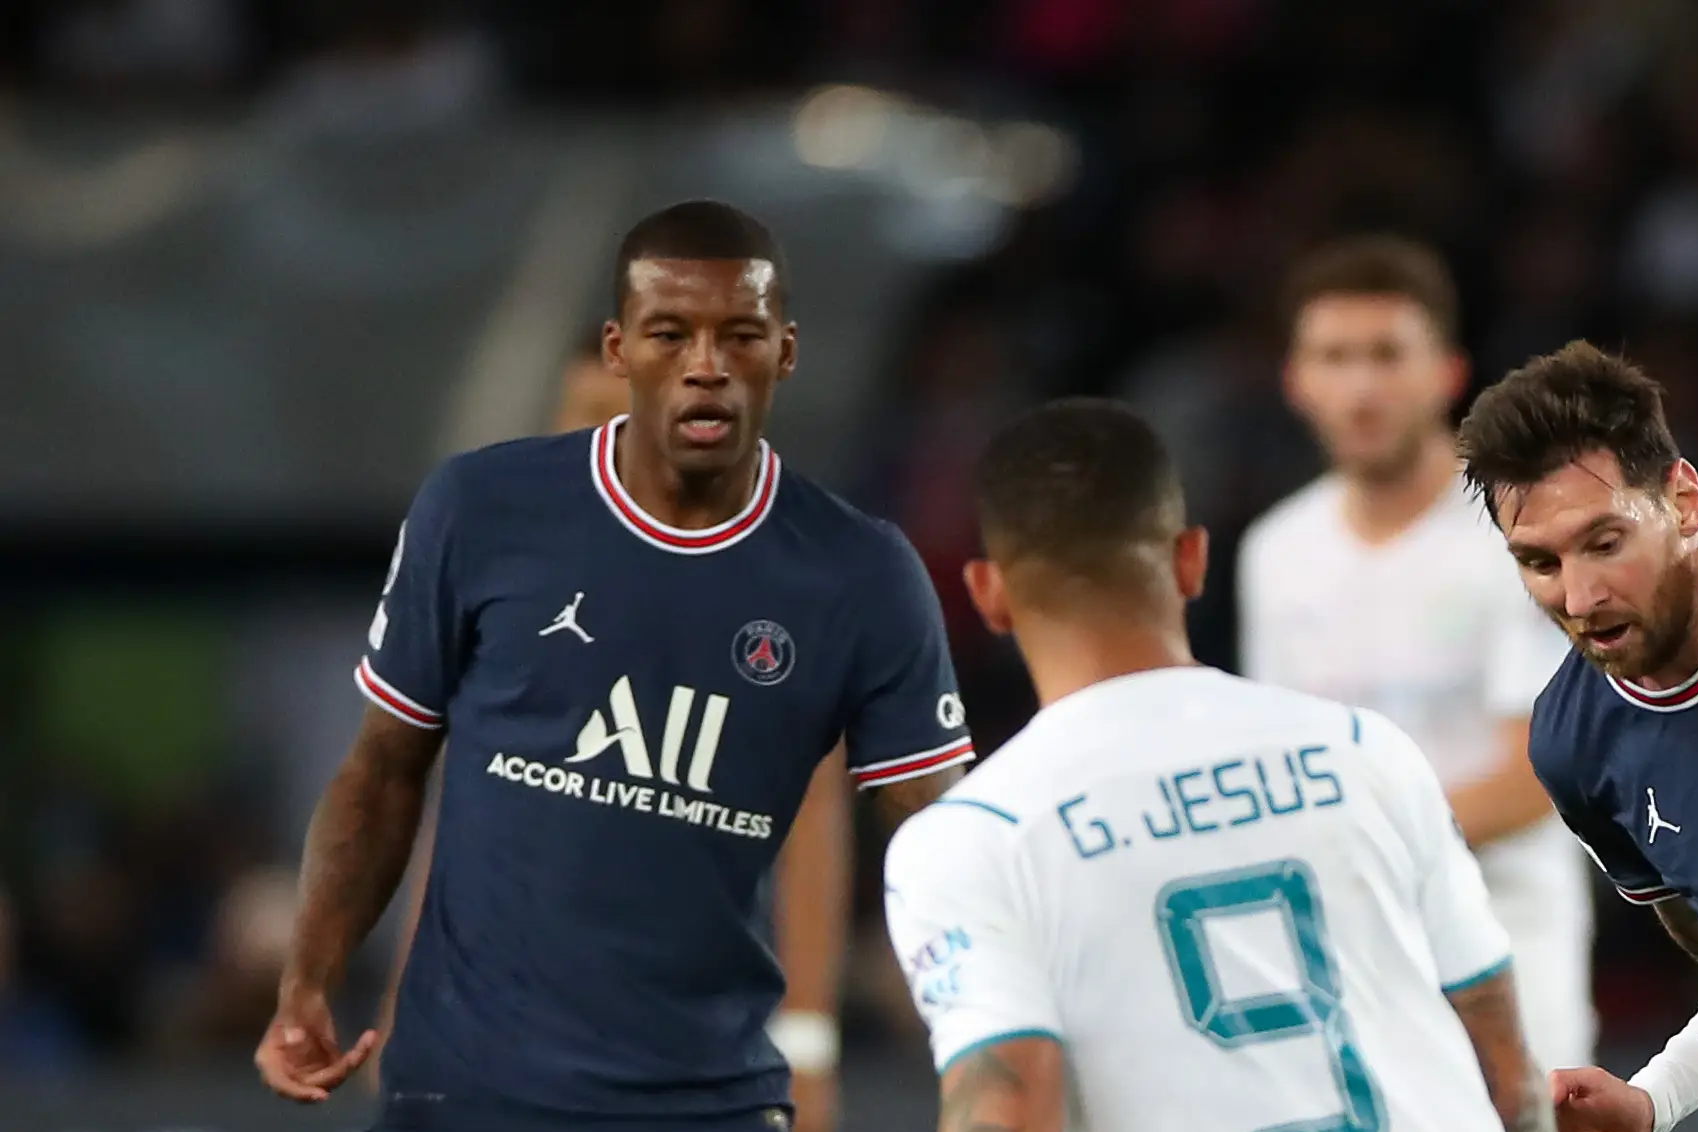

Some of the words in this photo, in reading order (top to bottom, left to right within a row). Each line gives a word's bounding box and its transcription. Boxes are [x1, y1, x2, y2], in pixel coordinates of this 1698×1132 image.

[486, 752, 586, 798] ACCOR
[589, 777, 656, 813] LIVE
[657, 791, 774, 840] LIMITLESS
[1057, 793, 1133, 859] G.
[1143, 745, 1345, 839] JESUS
